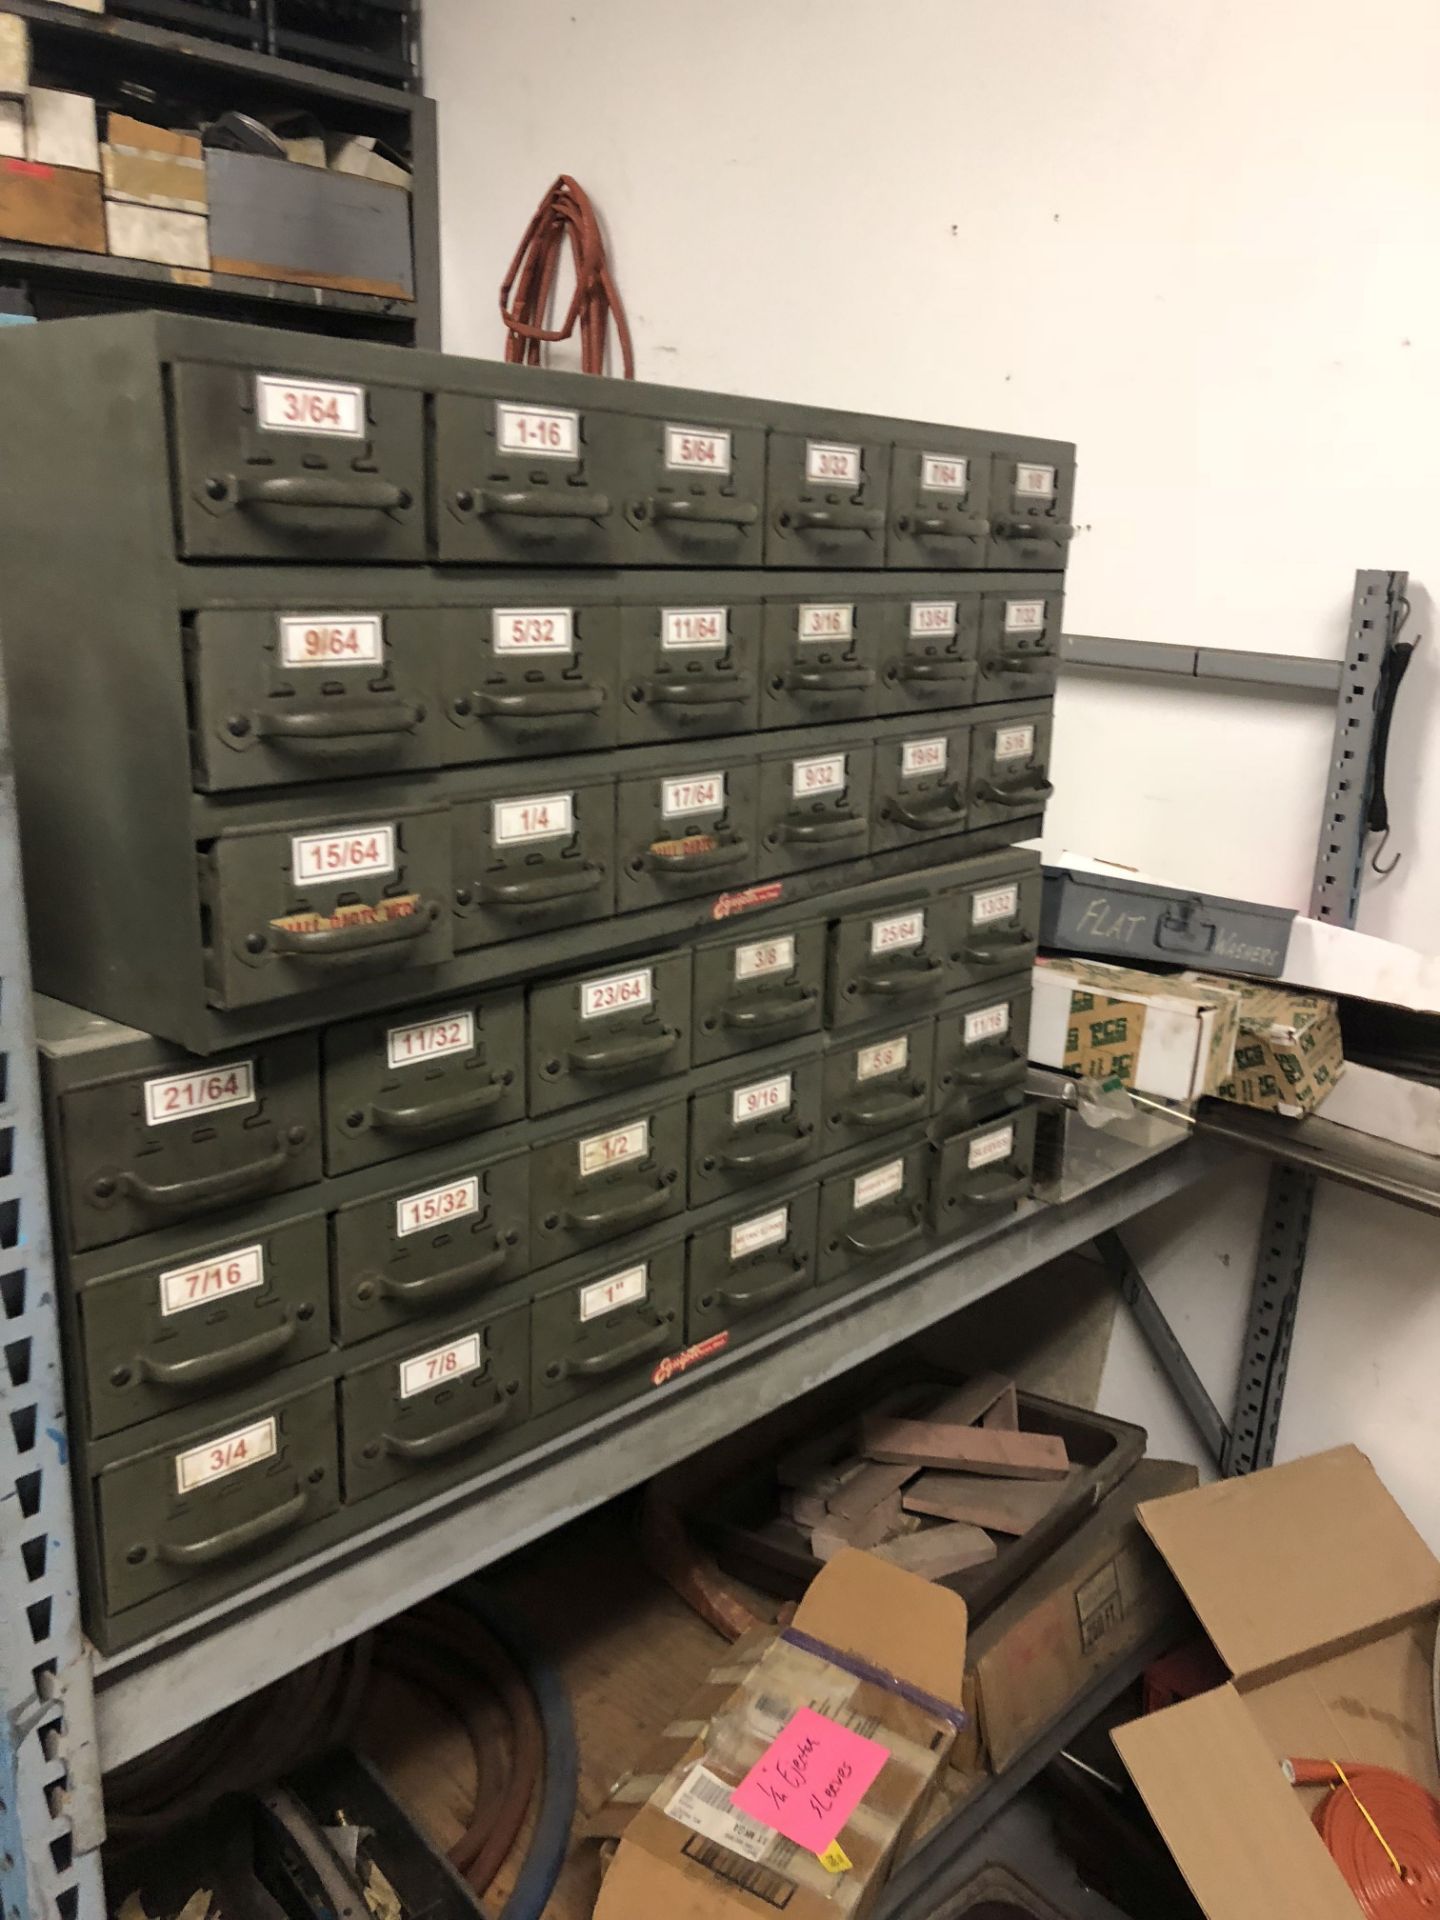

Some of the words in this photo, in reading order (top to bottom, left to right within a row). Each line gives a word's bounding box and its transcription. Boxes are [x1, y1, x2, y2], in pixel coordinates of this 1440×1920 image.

[284, 392, 340, 425] 3/64
[516, 419, 560, 446] 1-16
[680, 439, 715, 463] 5/64
[819, 453, 848, 475] 3/32
[673, 617, 716, 639] 11/64
[812, 612, 841, 632] 3/16
[919, 609, 949, 627] 13/64
[304, 629, 358, 656] 9/64
[513, 619, 555, 643] 5/32
[805, 766, 833, 788] 9/32
[673, 783, 715, 806] 17/64
[521, 806, 549, 831] 1/4
[311, 838, 379, 871] 15/64
[1076, 898, 1146, 943] FLAT
[880, 922, 915, 945] 25/64
[754, 946, 778, 968] 3/8
[593, 980, 641, 1009] 23/64
[973, 1013, 1002, 1034] 11/16
[403, 1022, 462, 1055] 11/32
[873, 1050, 894, 1068] 5/8
[163, 1072, 240, 1111] 21/64
[747, 1087, 779, 1110] 9/16
[411, 1189, 468, 1225] 15/32
[184, 1263, 241, 1298] 7/16
[603, 1281, 623, 1304] 1"
[423, 1351, 456, 1379] 7/8
[209, 1437, 248, 1471] 3/4
